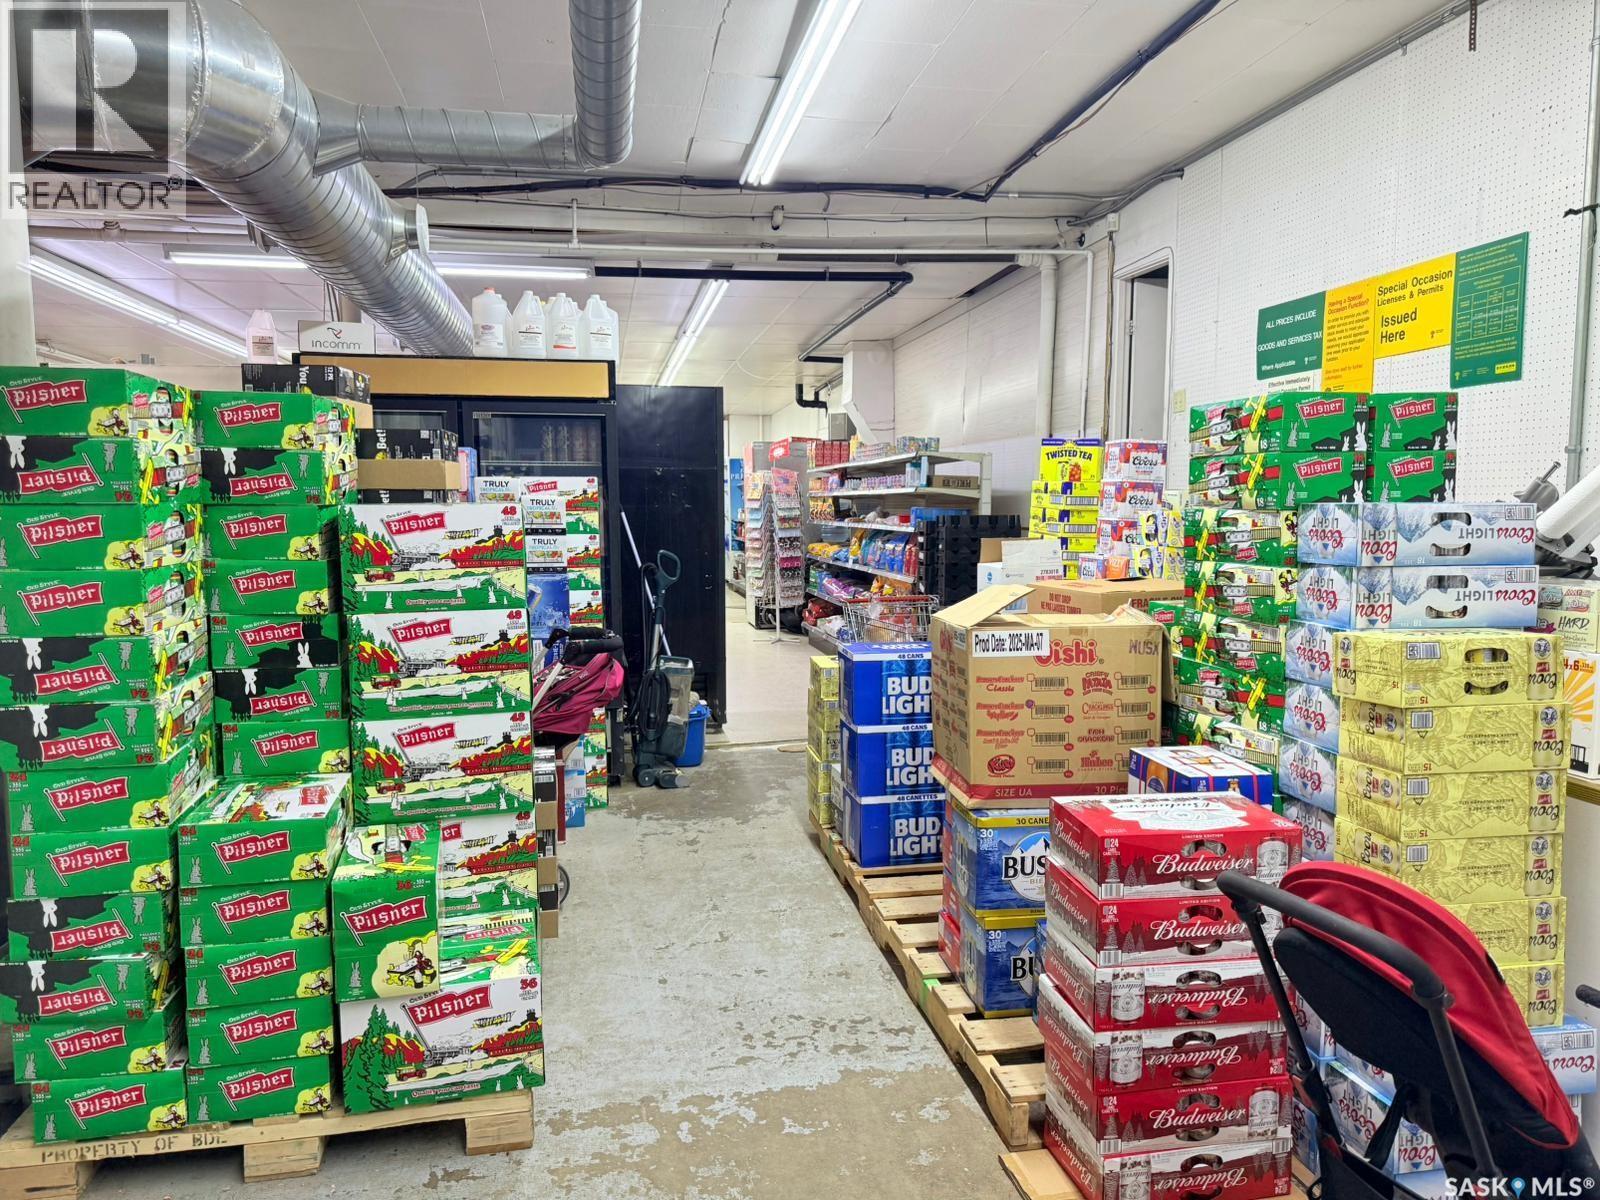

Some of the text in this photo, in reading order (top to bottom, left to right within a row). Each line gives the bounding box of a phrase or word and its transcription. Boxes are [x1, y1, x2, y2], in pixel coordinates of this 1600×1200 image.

[1378, 280, 1408, 297] Special
[1412, 270, 1453, 288] Occasion
[1377, 284, 1444, 307] Licenses & Permits
[1266, 320, 1274, 329] ALL
[1276, 315, 1294, 327] PRICES
[1294, 309, 1317, 323] INCLUDE
[1381, 306, 1418, 328] Issued
[312, 340, 361, 350] incomm
[1258, 330, 1322, 352] GOODS AND SERVICES TAX
[1380, 329, 1406, 344] Here
[1275, 360, 1296, 370] Applicable
[300, 366, 310, 384] You
[12, 384, 78, 406] Pilsner
[222, 407, 278, 424] Pilsner
[1302, 401, 1342, 416] Pilsner
[1394, 402, 1433, 417] Pilsner
[376, 429, 387, 450] Bet!
[1046, 449, 1092, 461] TWISTED TEA
[1132, 456, 1158, 467] Coors
[1300, 460, 1340, 476] Pilsner
[1392, 460, 1432, 476] Pilsner
[24, 468, 94, 490] Pilsner
[234, 476, 290, 492] Pilsner
[483, 480, 510, 488] TRULY
[379, 490, 390, 504] et!
[528, 484, 556, 493] Pilsner
[1128, 496, 1154, 506] Coors
[500, 506, 518, 516] 48
[29, 520, 96, 542] Pilsner
[229, 518, 284, 536] Pilsner
[389, 516, 441, 533] Pilsner
[1312, 517, 1338, 528] LIGHT
[1308, 528, 1344, 549] Coors
[1362, 530, 1398, 540] LIGHT
[1458, 527, 1534, 544] Coors LIGHT
[237, 573, 292, 592] Pilsner
[1309, 576, 1334, 589] LIGHT
[30, 587, 97, 612] Pilsner
[1306, 586, 1338, 610] Coors
[1358, 592, 1392, 603] LIGHT
[1455, 589, 1536, 606] Coors LIGHT
[506, 610, 522, 620] 48
[1558, 616, 1590, 630] HARD
[245, 626, 299, 646] Pilsner
[396, 622, 448, 640] Pilsner
[974, 633, 990, 652] Prod
[990, 632, 1007, 652] Date:
[1008, 632, 1044, 652] 2025-MA-07
[1300, 635, 1326, 650] LIGHT
[1296, 645, 1331, 672] Coors
[42, 668, 108, 688] Pilsner
[888, 676, 932, 695] BUD
[1082, 678, 1112, 690] PATATA
[986, 684, 1015, 692] Classic
[255, 695, 308, 712] Pilsner
[882, 696, 932, 715] LIGH
[1298, 694, 1322, 711] LIGHT
[510, 712, 526, 722] 48
[1294, 704, 1326, 732] Coors
[1259, 721, 1268, 732] 18
[47, 734, 112, 755] Pilsner
[261, 734, 314, 754] Pilsner
[401, 727, 452, 745] Pilsner
[892, 748, 936, 766] BUD
[1294, 752, 1318, 770] LIGHT
[1423, 763, 1432, 771] 15
[886, 767, 934, 786] LIGH
[1290, 762, 1322, 792] Coors
[57, 781, 123, 806] Pilsner
[996, 787, 1032, 798] SIZE UA
[1095, 785, 1108, 795] 30
[894, 817, 940, 837] BUD
[980, 829, 994, 838] 30
[1420, 830, 1428, 838] 15
[223, 836, 284, 860] Pilsner
[1054, 820, 1090, 860] Budweiser
[1110, 838, 1119, 848] 24
[58, 846, 124, 871] Pilsner
[1002, 855, 1047, 880] BUS
[1152, 854, 1254, 874] Budweiser
[223, 895, 284, 920] Pilsner
[1051, 882, 1088, 926] Budweiser
[1108, 906, 1118, 915] 24
[352, 903, 421, 930] Pilsner
[57, 923, 120, 946] Pilsner
[988, 930, 1002, 940] 30
[1150, 920, 1247, 940] Budweiser
[230, 956, 291, 980] Pilsner
[520, 978, 538, 990] 36
[48, 990, 105, 1010] Pilsner
[1149, 986, 1248, 1008] Budweiser
[414, 993, 486, 1022] Pilsner
[232, 1014, 292, 1039] Pilsner
[57, 1030, 120, 1055] Pilsner
[1146, 1044, 1242, 1068] Budweiser
[1552, 1054, 1594, 1072] Coors
[230, 1072, 289, 1096] Pilsner
[1050, 1055, 1088, 1112] Budweiser
[77, 1089, 140, 1114] Pilsner
[1108, 1096, 1118, 1106] 24
[1150, 1106, 1247, 1128] Budweiser
[42, 1140, 140, 1162] PROPERTY
[154, 1136, 178, 1150] OF
[1400, 1134, 1428, 1147] IGHT
[1051, 1129, 1094, 1193] Budweiser
[1154, 1167, 1248, 1191] Budweiser
